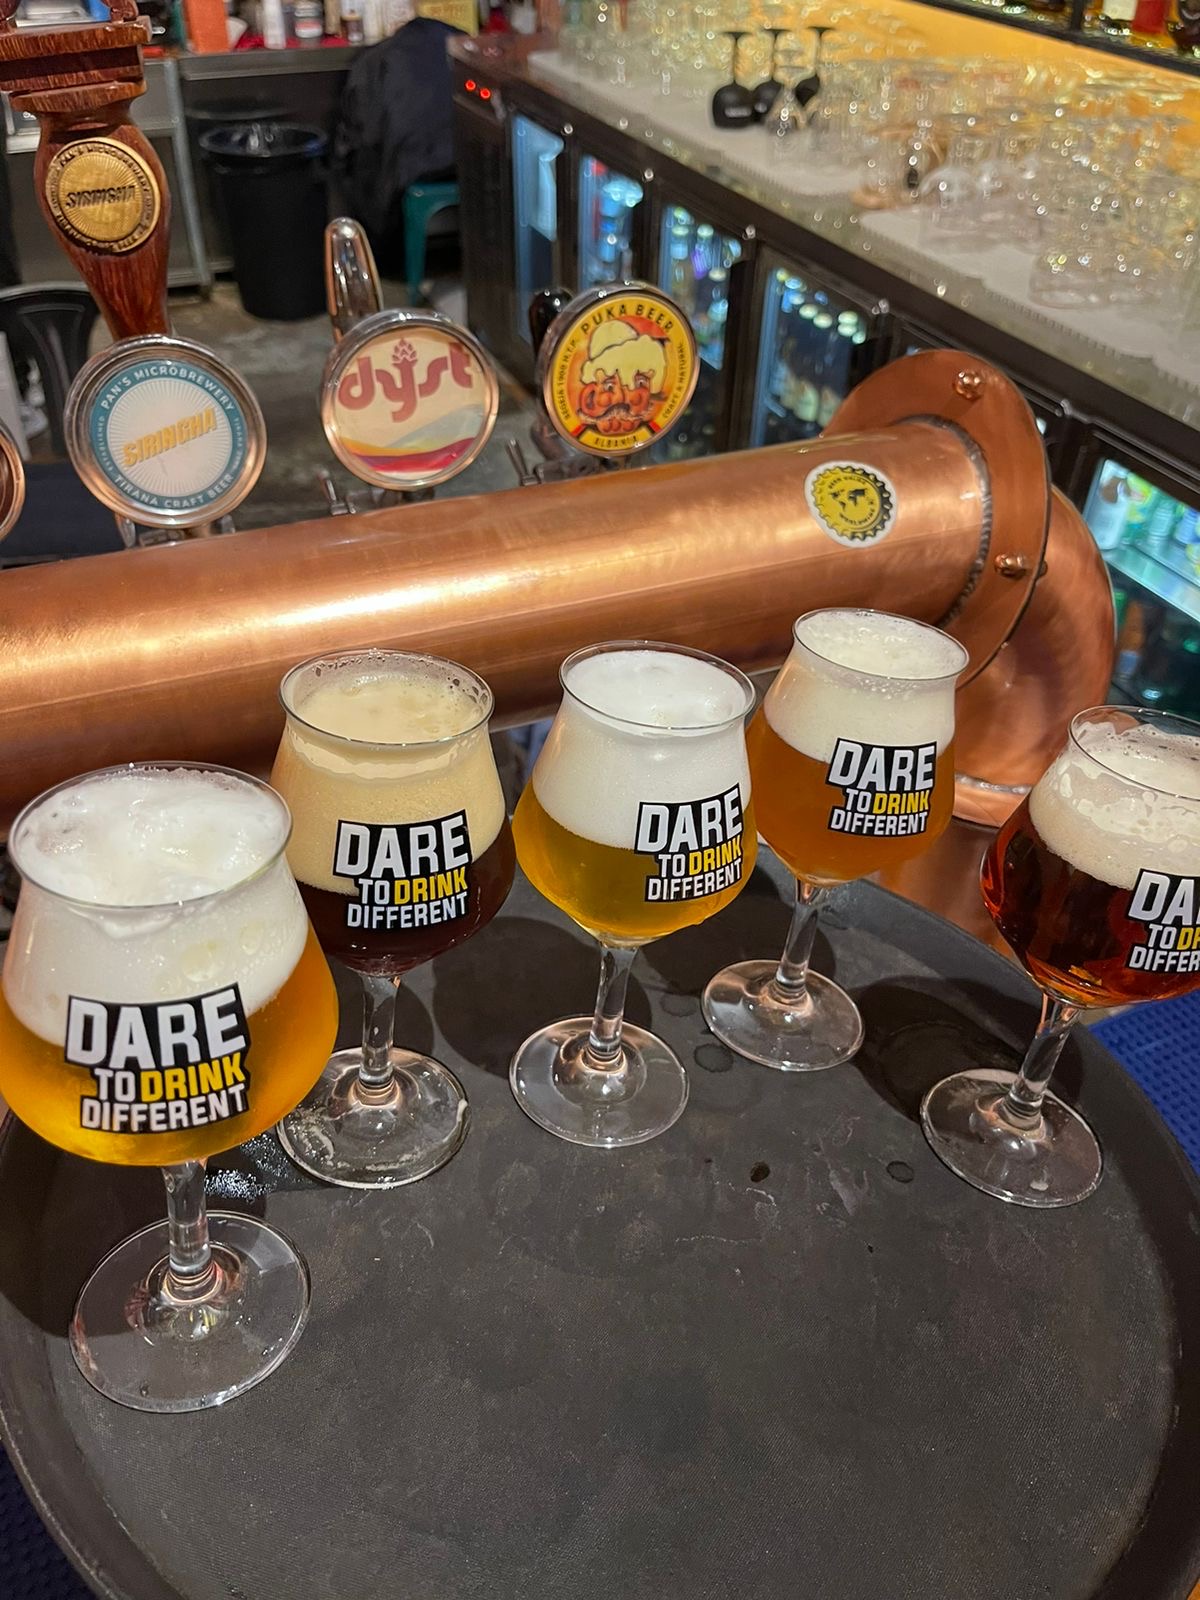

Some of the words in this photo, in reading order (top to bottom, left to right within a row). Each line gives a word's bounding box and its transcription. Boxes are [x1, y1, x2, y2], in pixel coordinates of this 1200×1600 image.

[580, 304, 628, 336] PUKA
[635, 304, 674, 333] BEER
[101, 376, 132, 410] PAN'S
[134, 365, 235, 411] MICROBREWERY
[338, 338, 473, 423] dyst
[114, 474, 159, 507] TIRANA
[164, 493, 205, 509] CRAFT
[207, 473, 235, 499] BEER
[828, 740, 935, 792] DARE
[636, 787, 743, 852] DARE
[830, 811, 928, 836] DIFFERENT
[846, 788, 872, 813] TO
[872, 789, 930, 815] DRINK
[335, 814, 469, 878] DARE
[658, 853, 686, 878] TO
[689, 834, 742, 876] DRINK
[358, 878, 390, 905] TO
[394, 866, 468, 905] DRINK
[648, 857, 742, 900] DIFFERENT
[1128, 871, 1200, 926] DA
[347, 891, 468, 929] DIFFERENT
[1147, 923, 1177, 949] TO
[66, 988, 246, 1069] DARE
[94, 1067, 136, 1103] TO
[140, 1052, 246, 1103] DRINK
[82, 1083, 246, 1132] DIFFERENT
